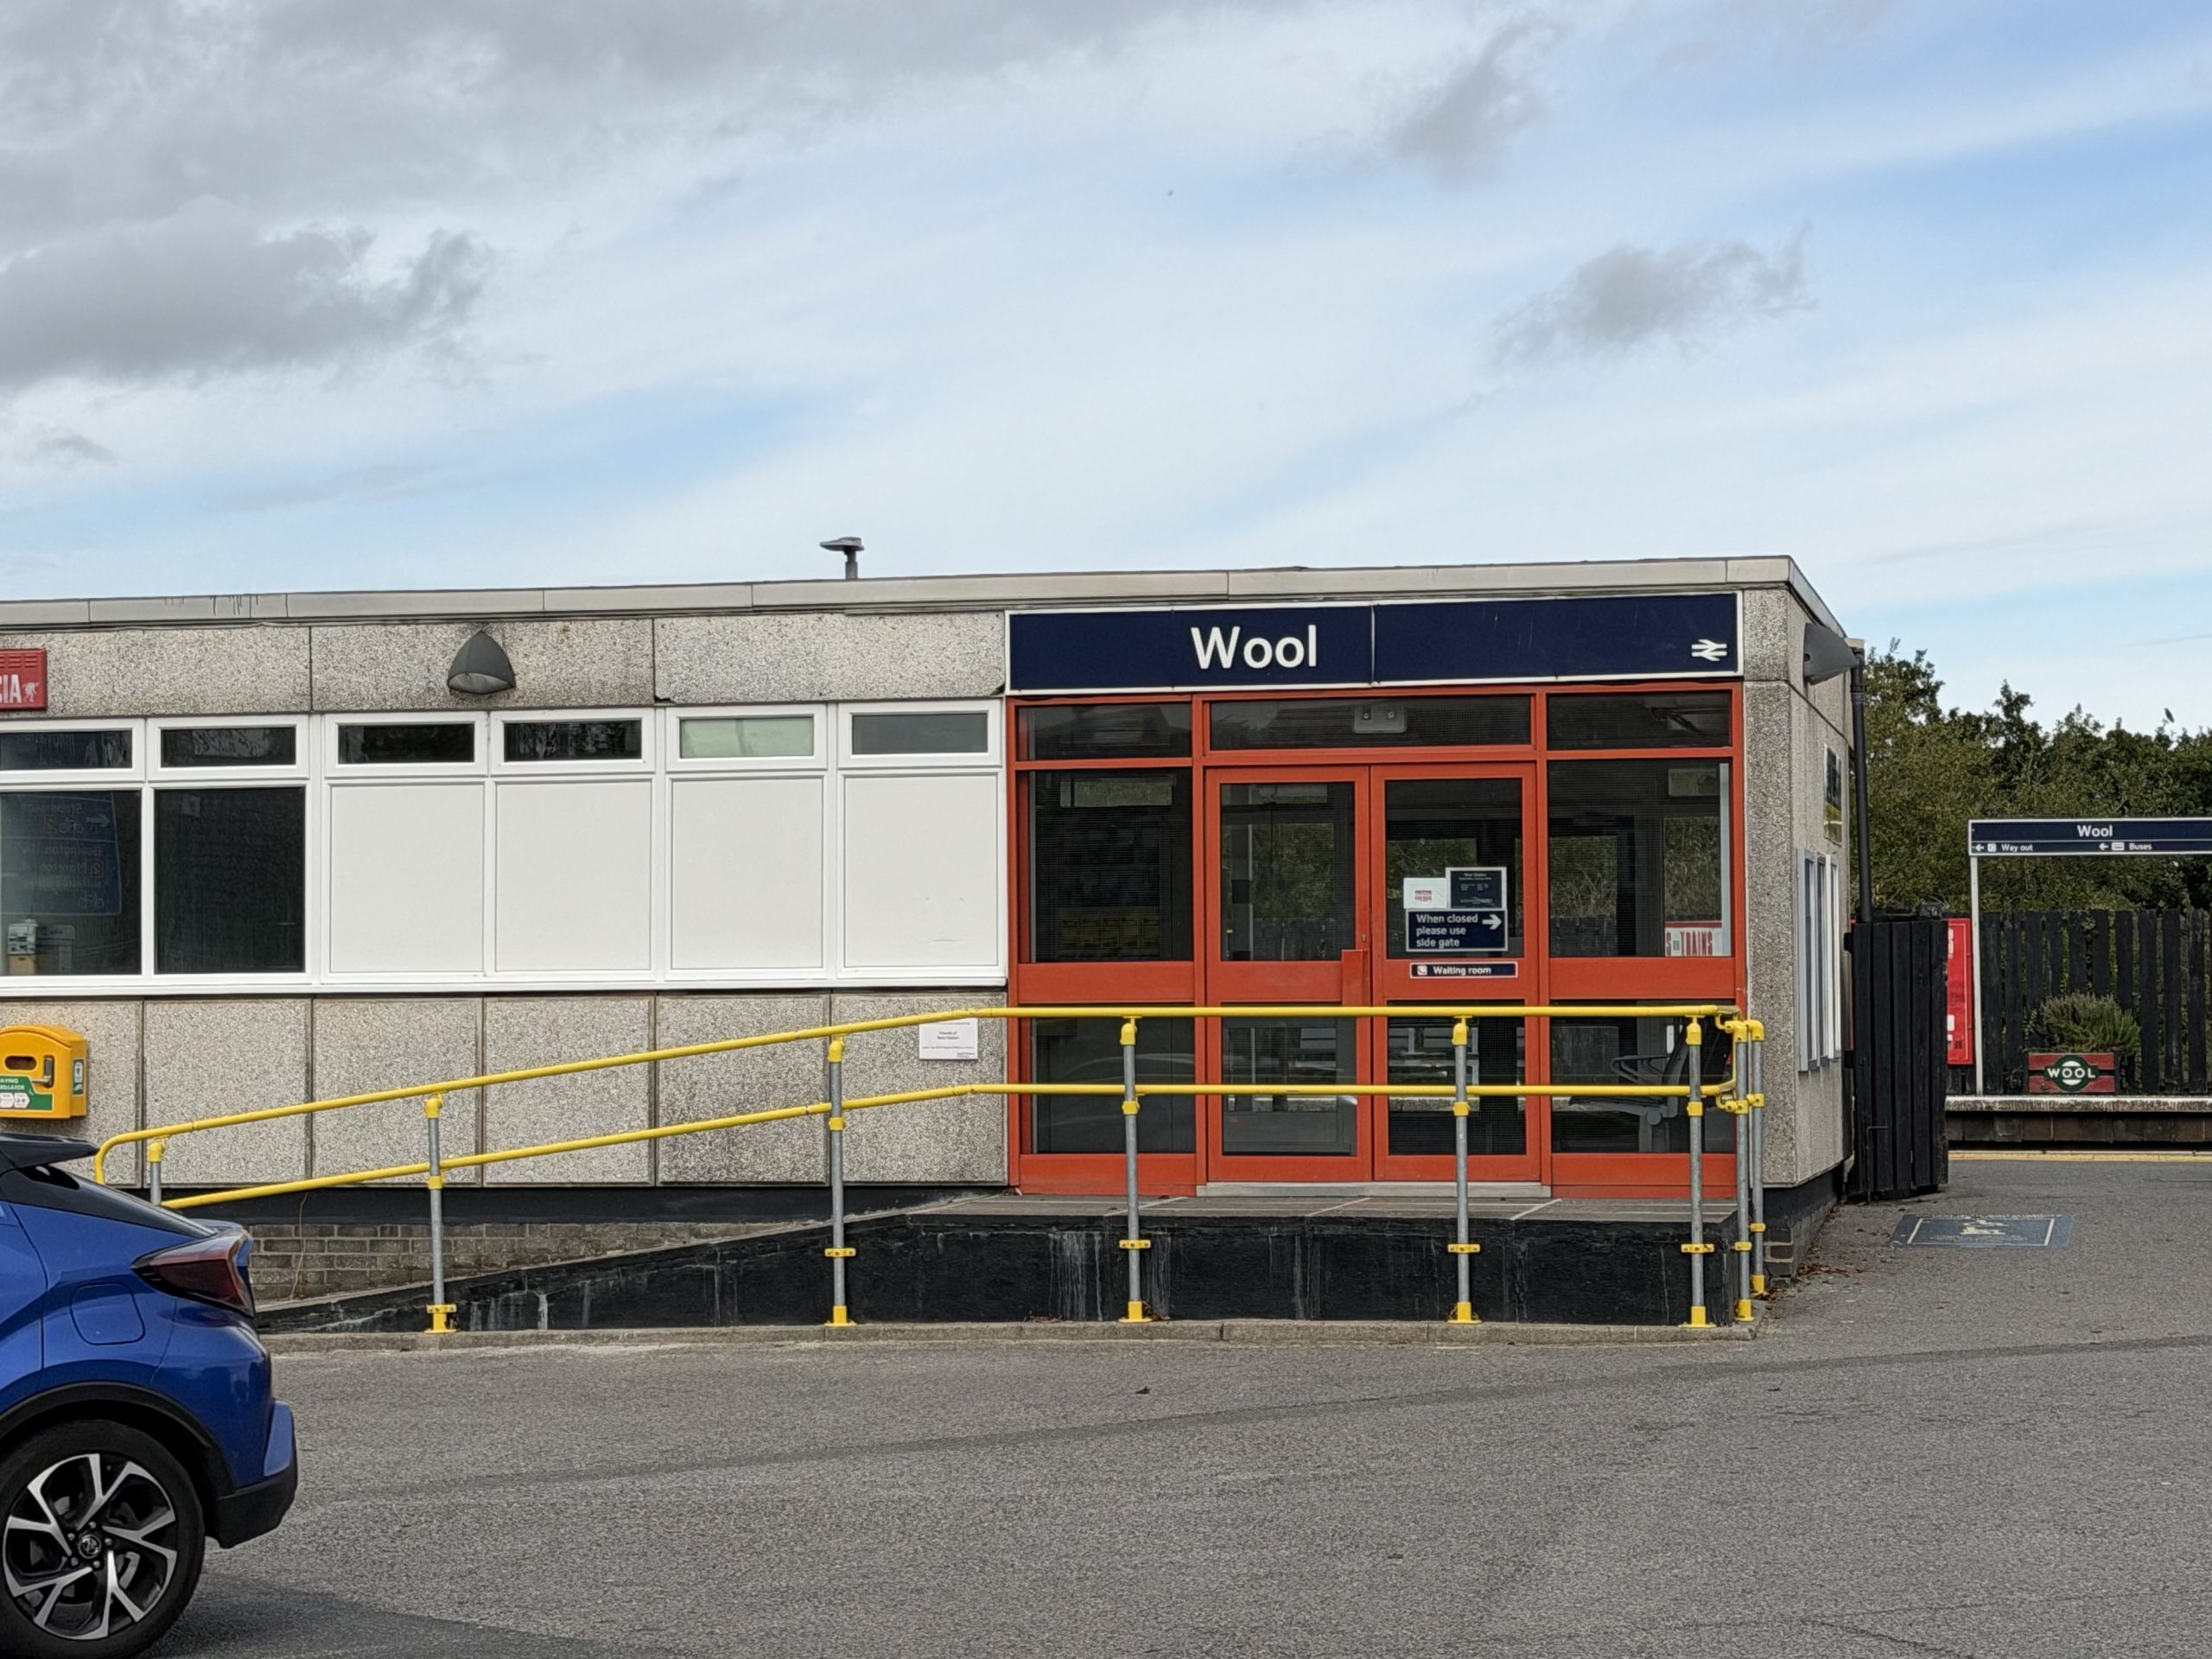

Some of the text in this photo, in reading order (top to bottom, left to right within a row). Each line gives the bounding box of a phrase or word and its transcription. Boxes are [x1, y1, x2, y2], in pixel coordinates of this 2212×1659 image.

[1191, 624, 1317, 670] Wool
[2076, 824, 2113, 837] Wool
[2001, 843, 2018, 852] Way
[1415, 913, 1478, 924] When closed
[1415, 926, 1447, 938] please
[1415, 938, 1460, 949] side gate
[1433, 966, 1466, 976] Waiting
[2046, 1067, 2097, 1078] WOOL
